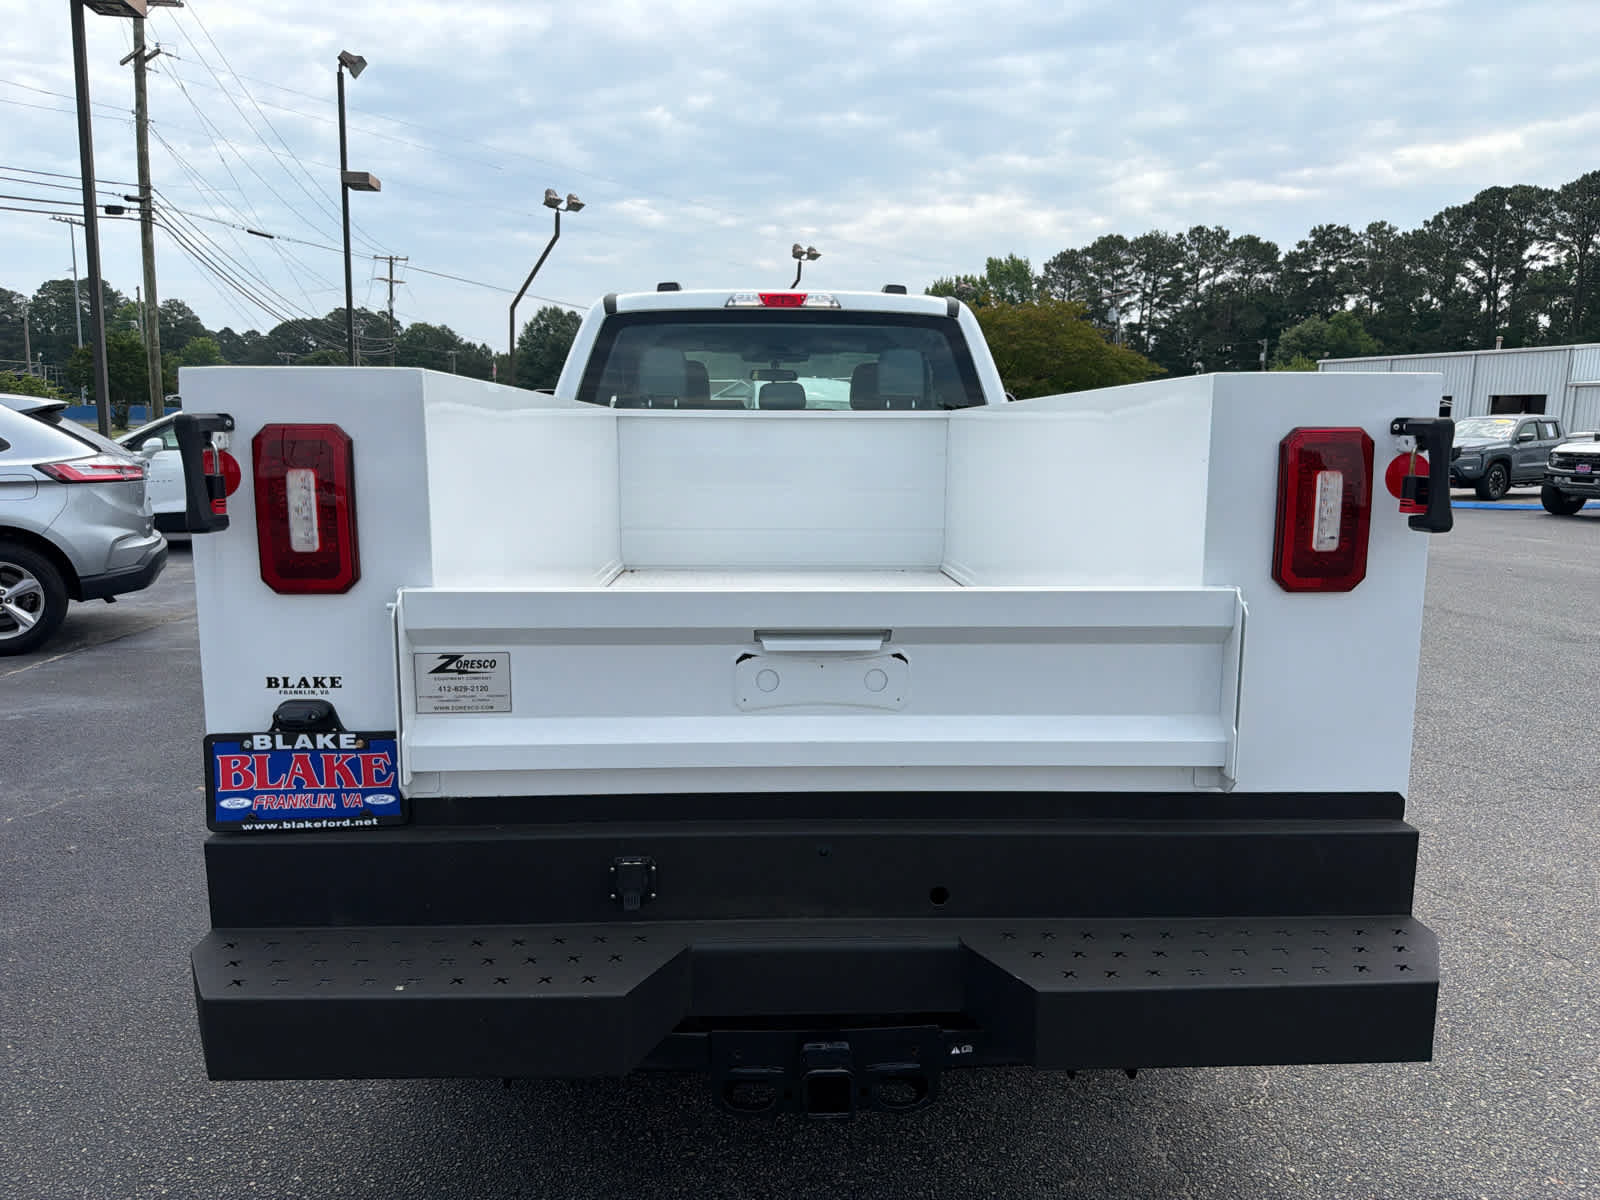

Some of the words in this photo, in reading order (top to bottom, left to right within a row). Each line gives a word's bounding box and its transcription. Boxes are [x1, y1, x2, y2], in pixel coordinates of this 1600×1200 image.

[428, 654, 497, 675] ZORESCO
[266, 676, 342, 689] BLAKE
[252, 734, 357, 750] BLAKE
[216, 752, 394, 791] BLAKE
[252, 795, 336, 810] FRANKLIN,
[342, 793, 363, 808] VA
[242, 818, 378, 830] www.blakeford.net
